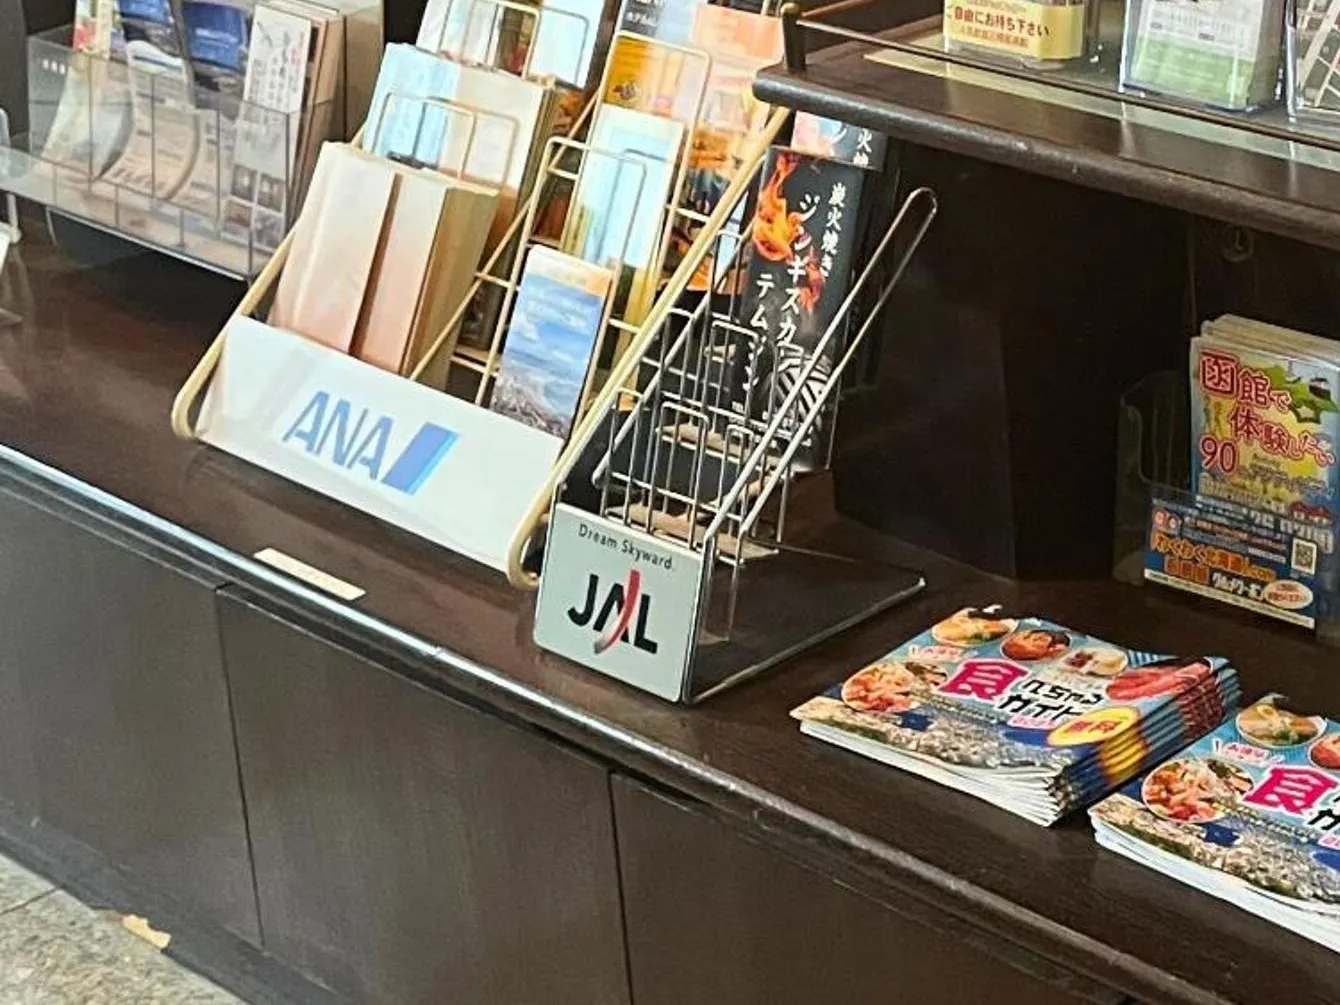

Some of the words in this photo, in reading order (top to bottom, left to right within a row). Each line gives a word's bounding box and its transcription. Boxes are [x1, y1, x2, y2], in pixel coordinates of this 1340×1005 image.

[820, 181, 847, 278] 炭火焼き
[1199, 349, 1293, 415] 函館で
[282, 391, 394, 481] ANA
[1200, 435, 1238, 476] 90
[578, 523, 618, 549] Dream
[621, 538, 673, 571] Skyward
[567, 569, 658, 654] JAL
[938, 660, 1030, 701] 食
[1243, 767, 1340, 815] 食
